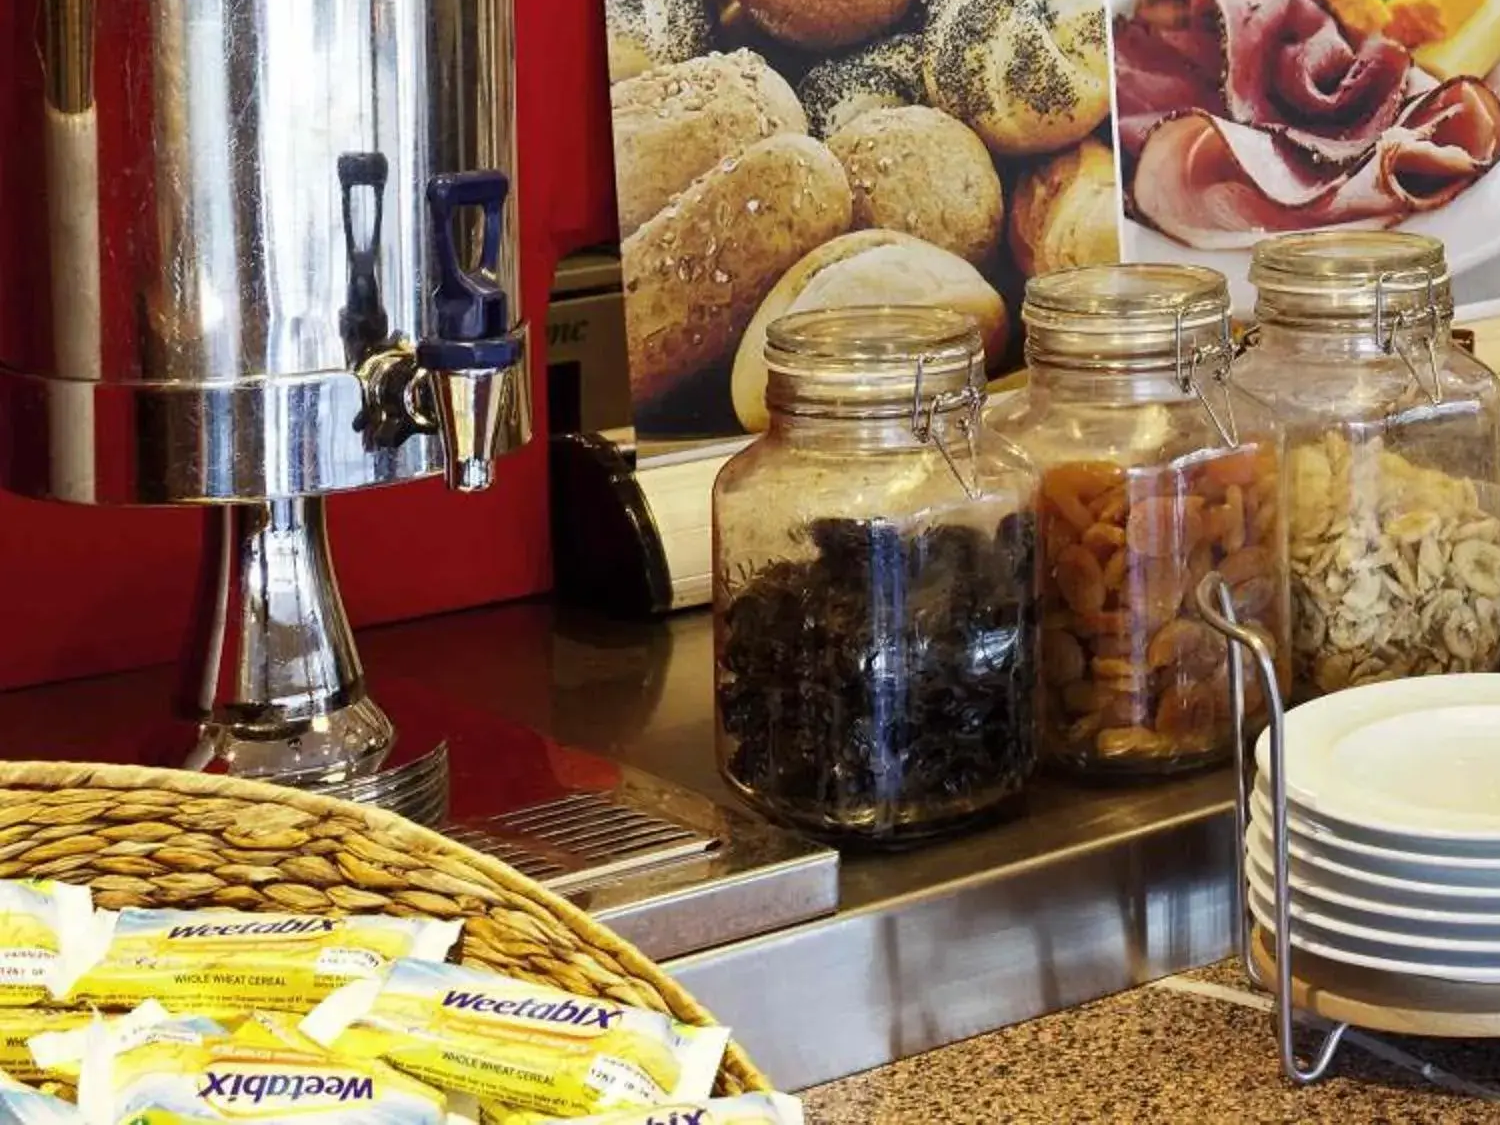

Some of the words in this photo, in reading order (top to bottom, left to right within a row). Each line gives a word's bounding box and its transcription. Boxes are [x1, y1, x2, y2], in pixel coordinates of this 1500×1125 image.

[173, 973, 209, 984] WHOLE
[213, 974, 246, 985] WHEAT
[248, 975, 287, 986] CEREAL
[442, 1050, 478, 1068] WHOLE
[480, 1060, 516, 1077] WHEAT
[517, 1069, 555, 1087] CEREAL
